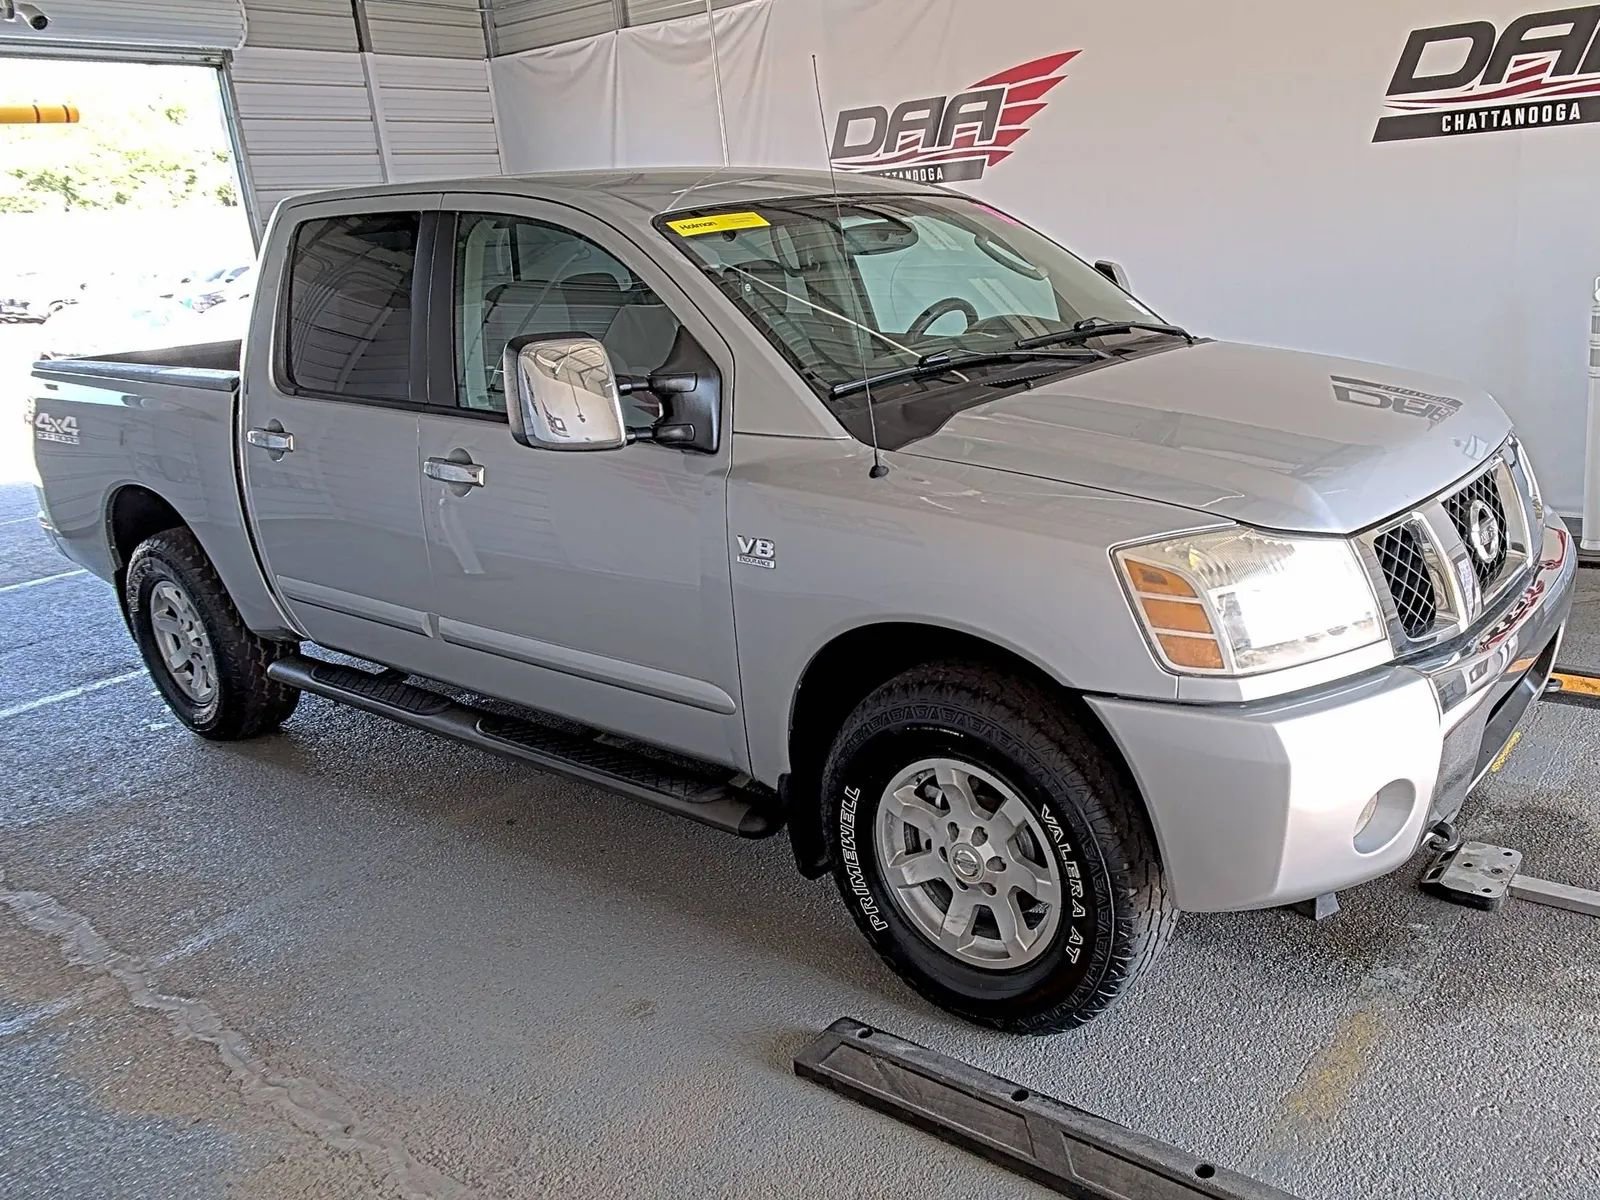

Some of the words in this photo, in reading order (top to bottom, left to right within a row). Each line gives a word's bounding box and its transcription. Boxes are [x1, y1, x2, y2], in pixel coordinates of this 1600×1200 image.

[1385, 4, 1600, 96] DA
[830, 87, 1006, 158] DAA
[1441, 102, 1581, 132] CHATTANOOGA
[840, 786, 888, 932] PRIMEWELL
[1041, 804, 1086, 918] VALERA
[1065, 926, 1084, 964] AT
